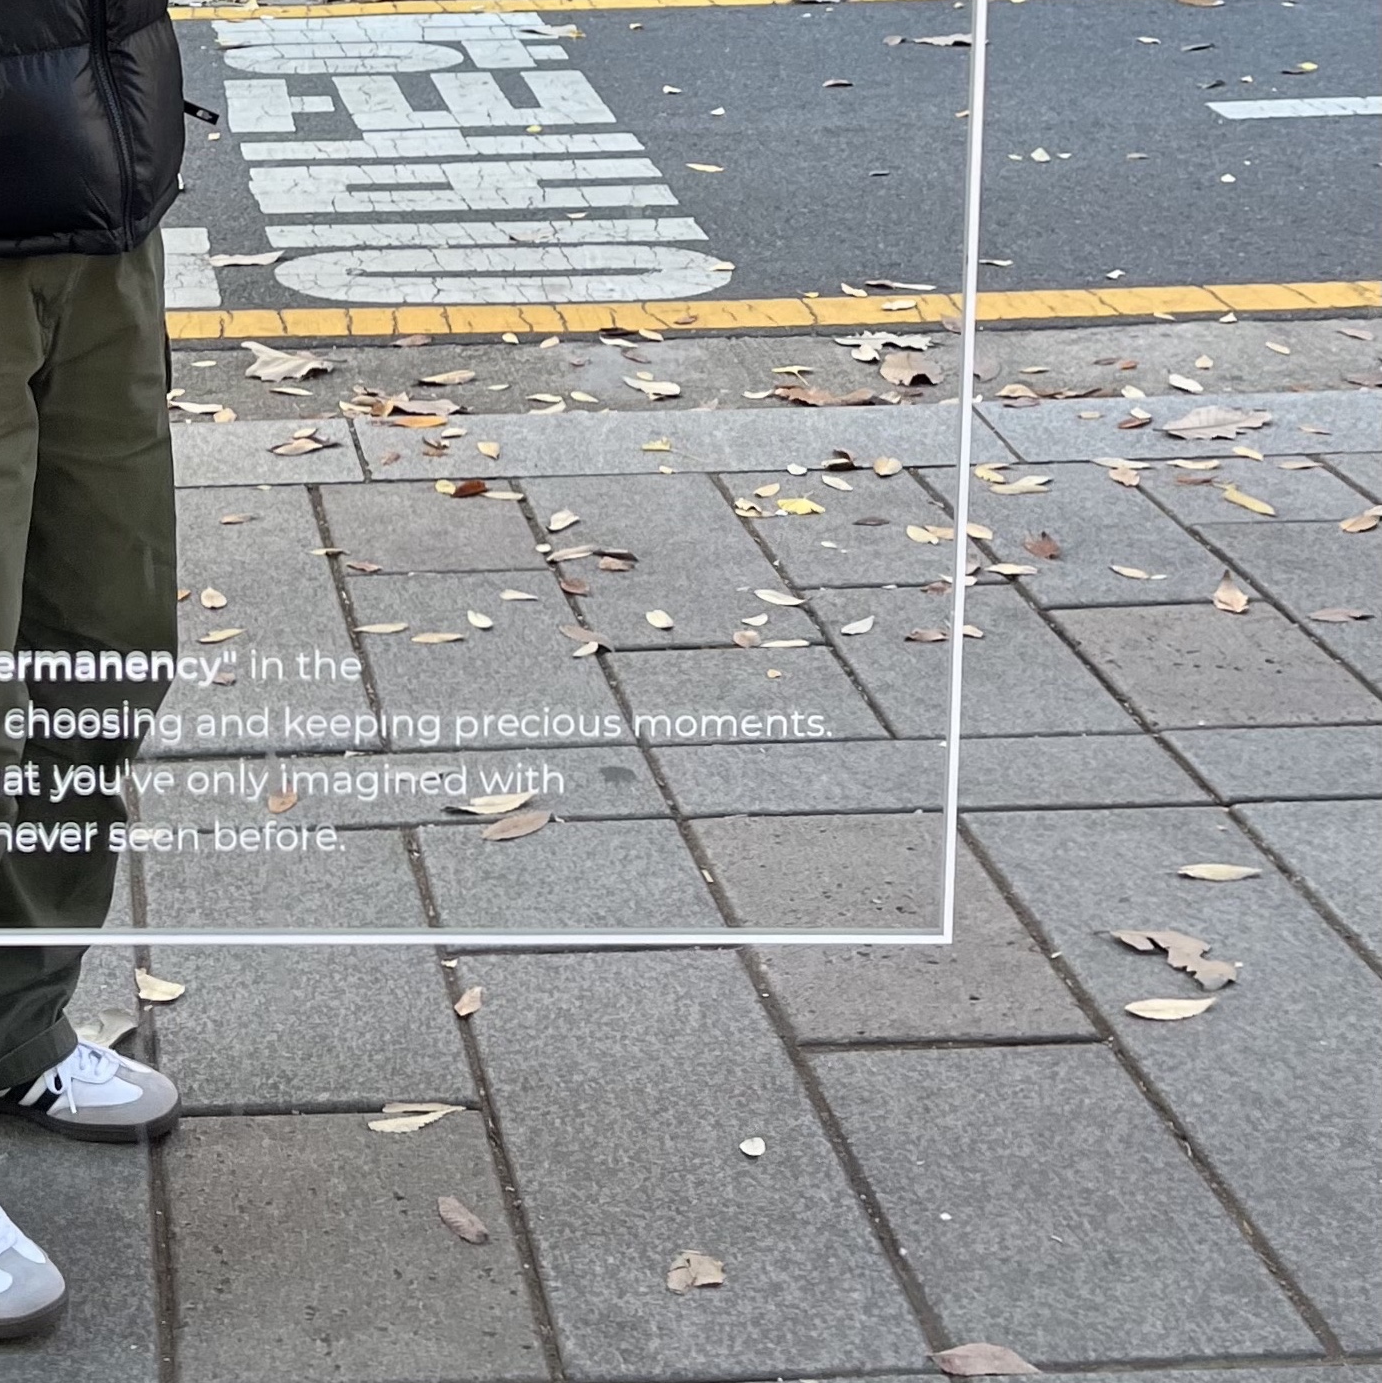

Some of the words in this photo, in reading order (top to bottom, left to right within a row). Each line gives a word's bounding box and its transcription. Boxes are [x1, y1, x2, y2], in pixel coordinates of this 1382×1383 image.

[251, 649, 284, 681] in
[297, 649, 363, 682] the
[4, 702, 182, 744] choosing
[196, 706, 270, 739] and
[284, 706, 440, 745] keeping
[455, 706, 622, 745] precious
[635, 710, 833, 739] moments.
[49, 760, 176, 802] you've
[186, 762, 269, 801] only
[279, 764, 468, 801] imagined
[479, 763, 566, 795] with
[108, 824, 200, 853] seen
[213, 820, 347, 853] before.
